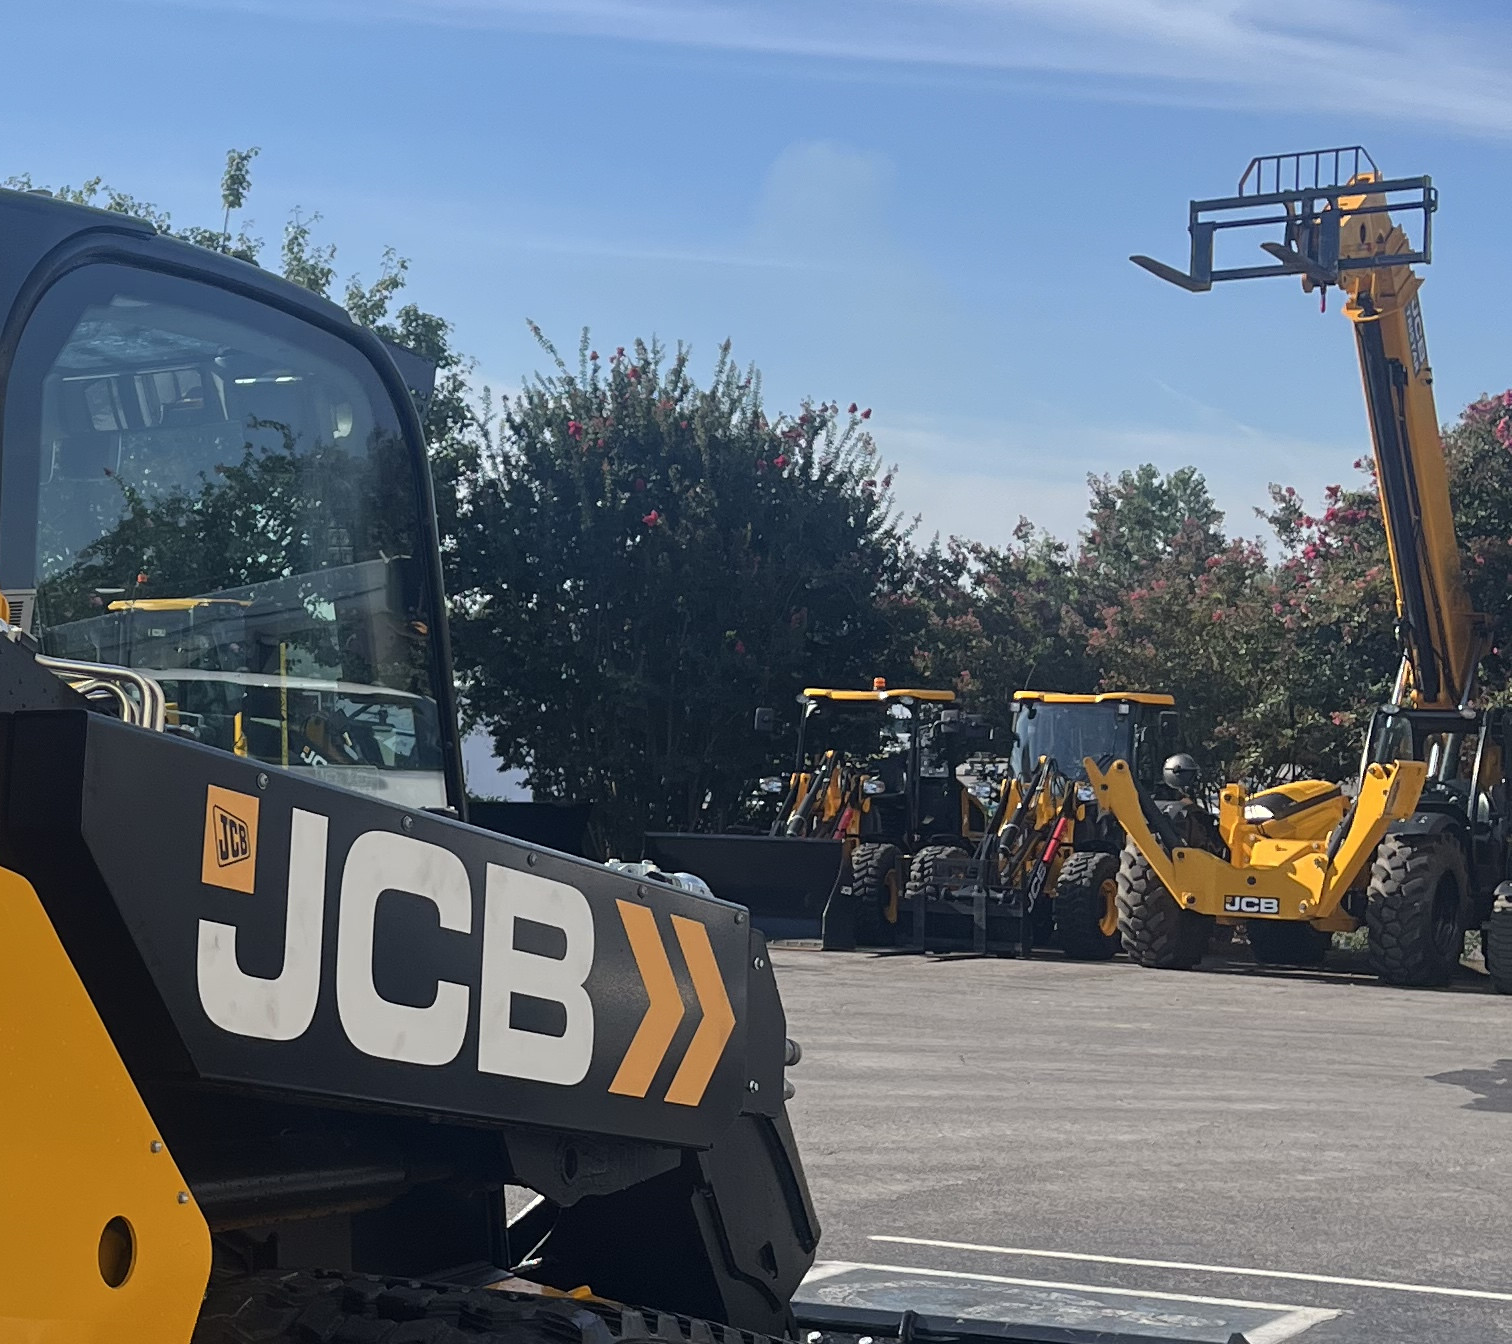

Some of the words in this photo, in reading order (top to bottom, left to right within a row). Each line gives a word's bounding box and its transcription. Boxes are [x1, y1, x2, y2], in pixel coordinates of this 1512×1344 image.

[218, 814, 249, 861] JCB
[1225, 896, 1278, 914] JCB
[197, 807, 594, 1086] JCB
